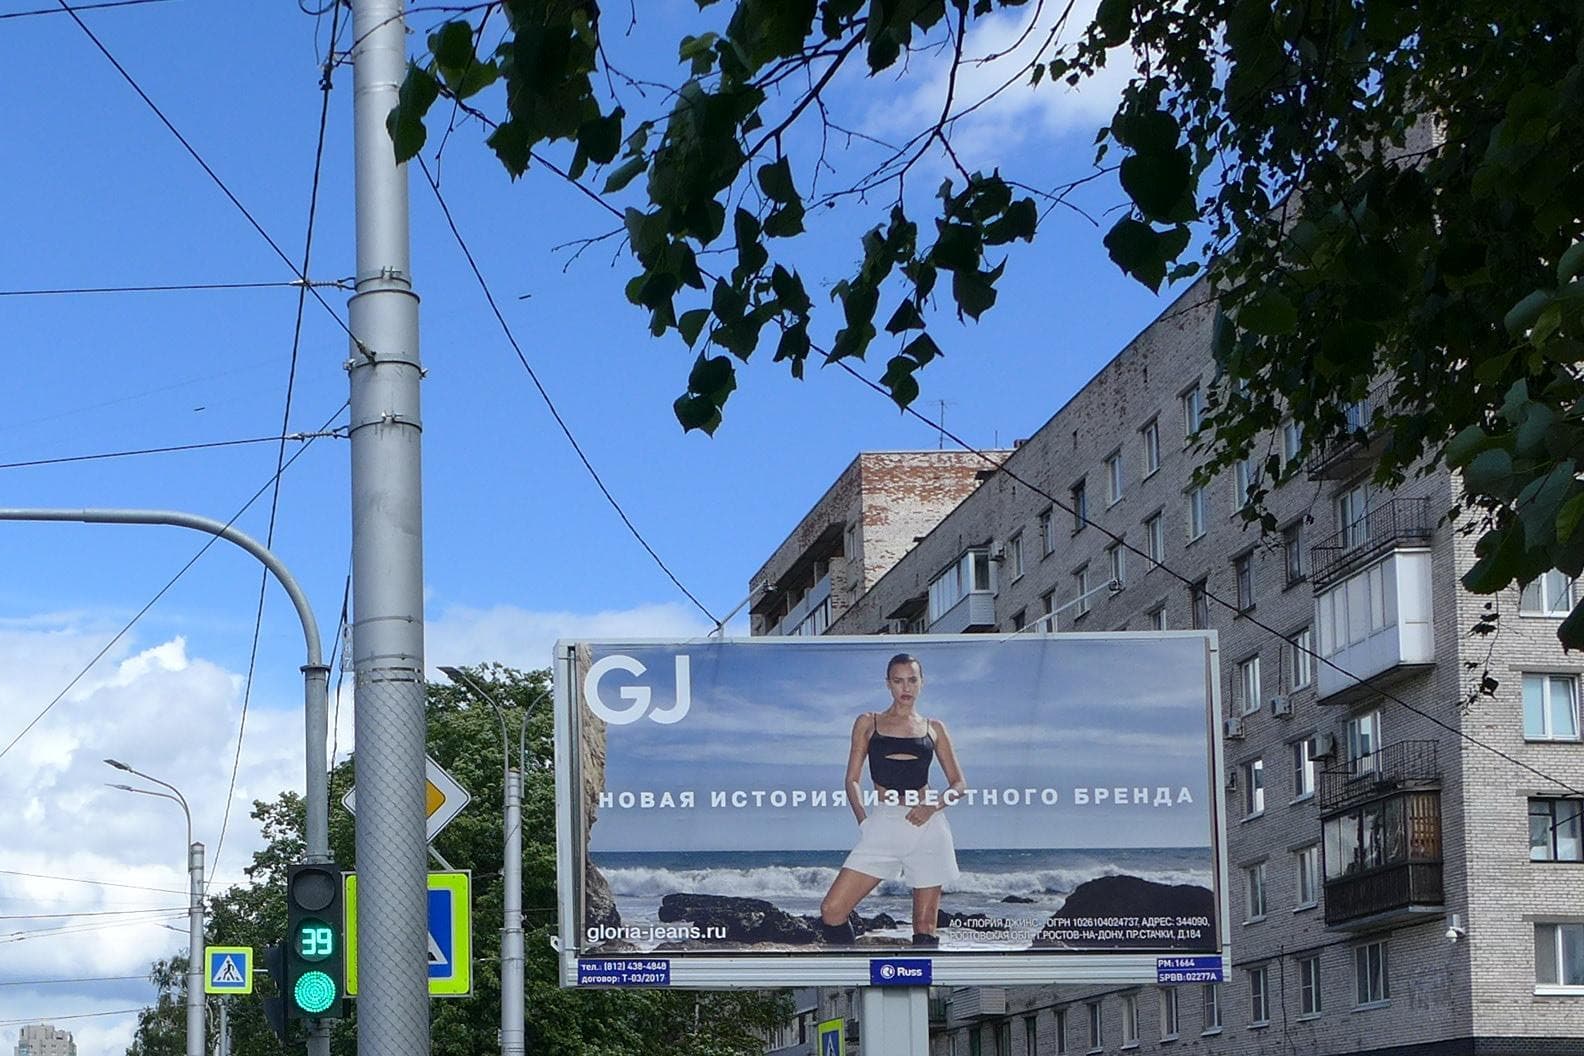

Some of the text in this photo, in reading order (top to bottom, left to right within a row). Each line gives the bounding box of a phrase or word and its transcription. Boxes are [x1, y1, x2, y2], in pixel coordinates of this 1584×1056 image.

[583, 654, 691, 725] GJ
[598, 786, 1194, 809] НОВАЯ ИСТОРИЯ ИЗВЕСТНОГО БРЕНДА
[949, 918, 962, 928] АО
[1046, 917, 1071, 928] ОГРН
[1141, 916, 1175, 928] АДРЕС:
[1176, 916, 1210, 928] 344090,
[586, 923, 727, 943] gloria-jeans.ru
[950, 930, 1010, 941] РОСТОВСКАЯ
[302, 928, 332, 955] 39
[604, 961, 626, 971] (812)
[897, 967, 923, 977] Russ
[582, 973, 665, 984] договор: Т-03/2017
